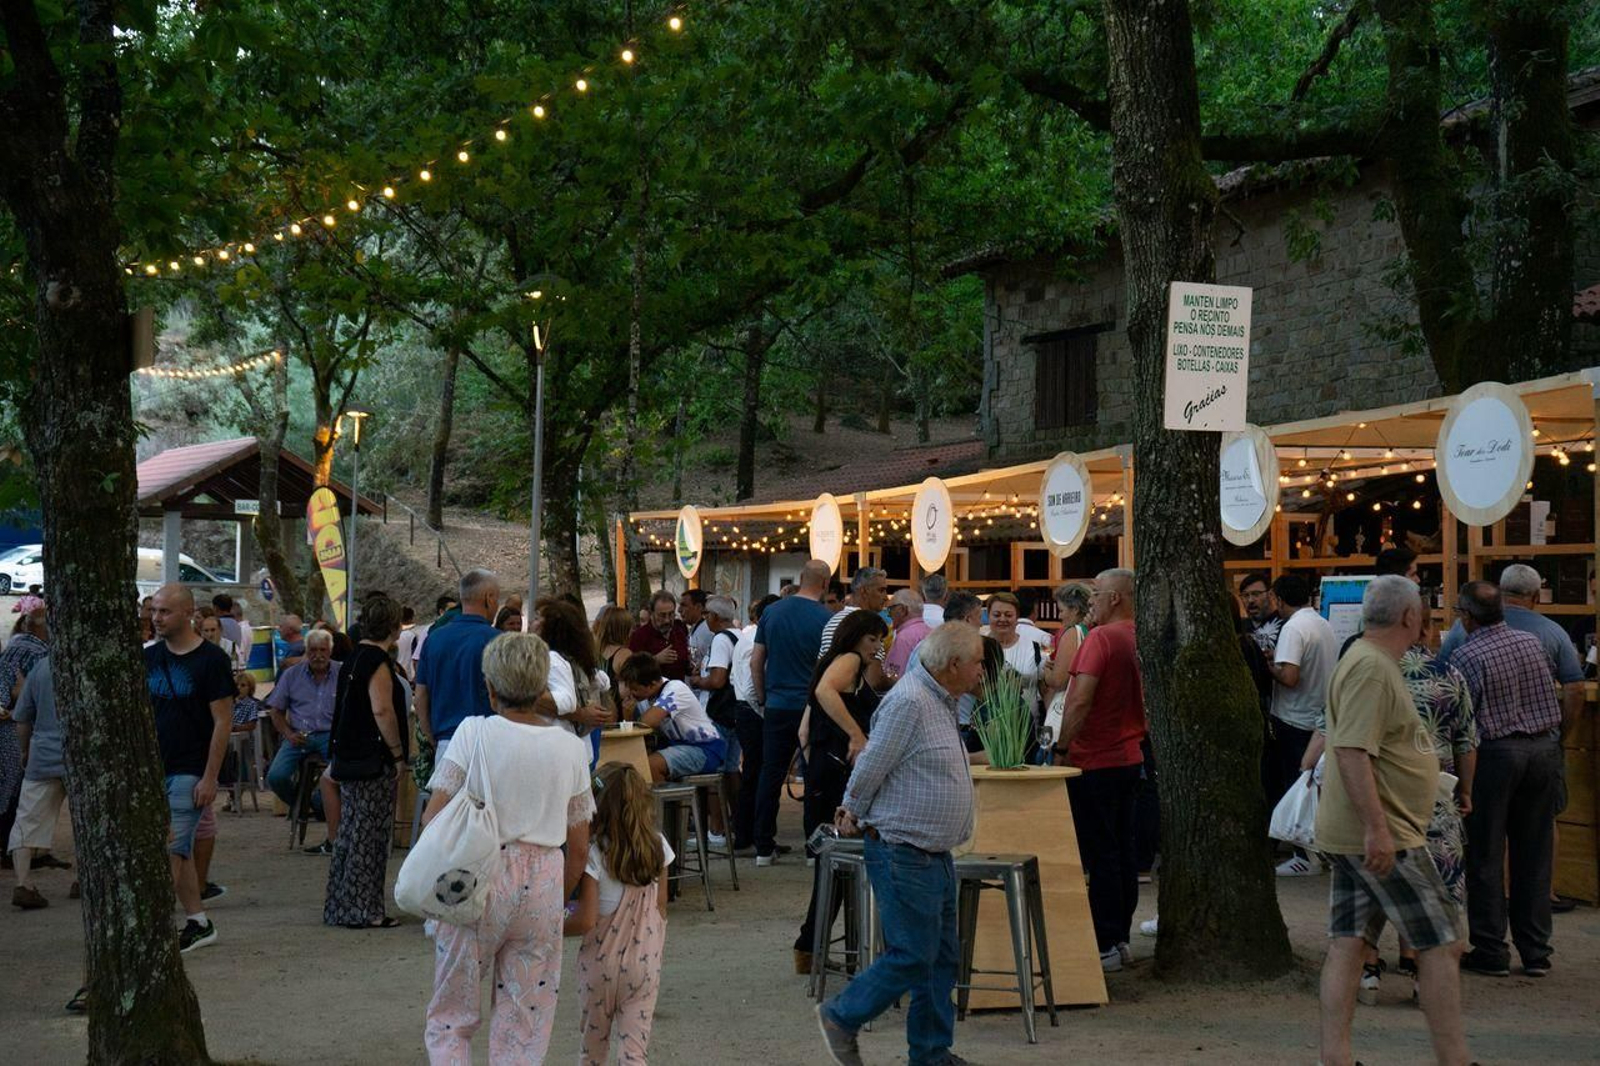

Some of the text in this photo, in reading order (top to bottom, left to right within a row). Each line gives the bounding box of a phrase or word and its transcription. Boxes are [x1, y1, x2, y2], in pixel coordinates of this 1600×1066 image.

[1183, 294, 1238, 309] MANTEN LIMPO
[1190, 309, 1230, 322] O RECINTO
[1173, 321, 1198, 334] PENSA
[1217, 324, 1245, 337] DEMAIS
[1173, 344, 1187, 357] LIXO
[1193, 345, 1245, 360] CONTENEDORES
[1177, 358, 1211, 372] BOTELLAS
[1216, 360, 1239, 374] CAIXAS
[1183, 385, 1227, 424] Gracias
